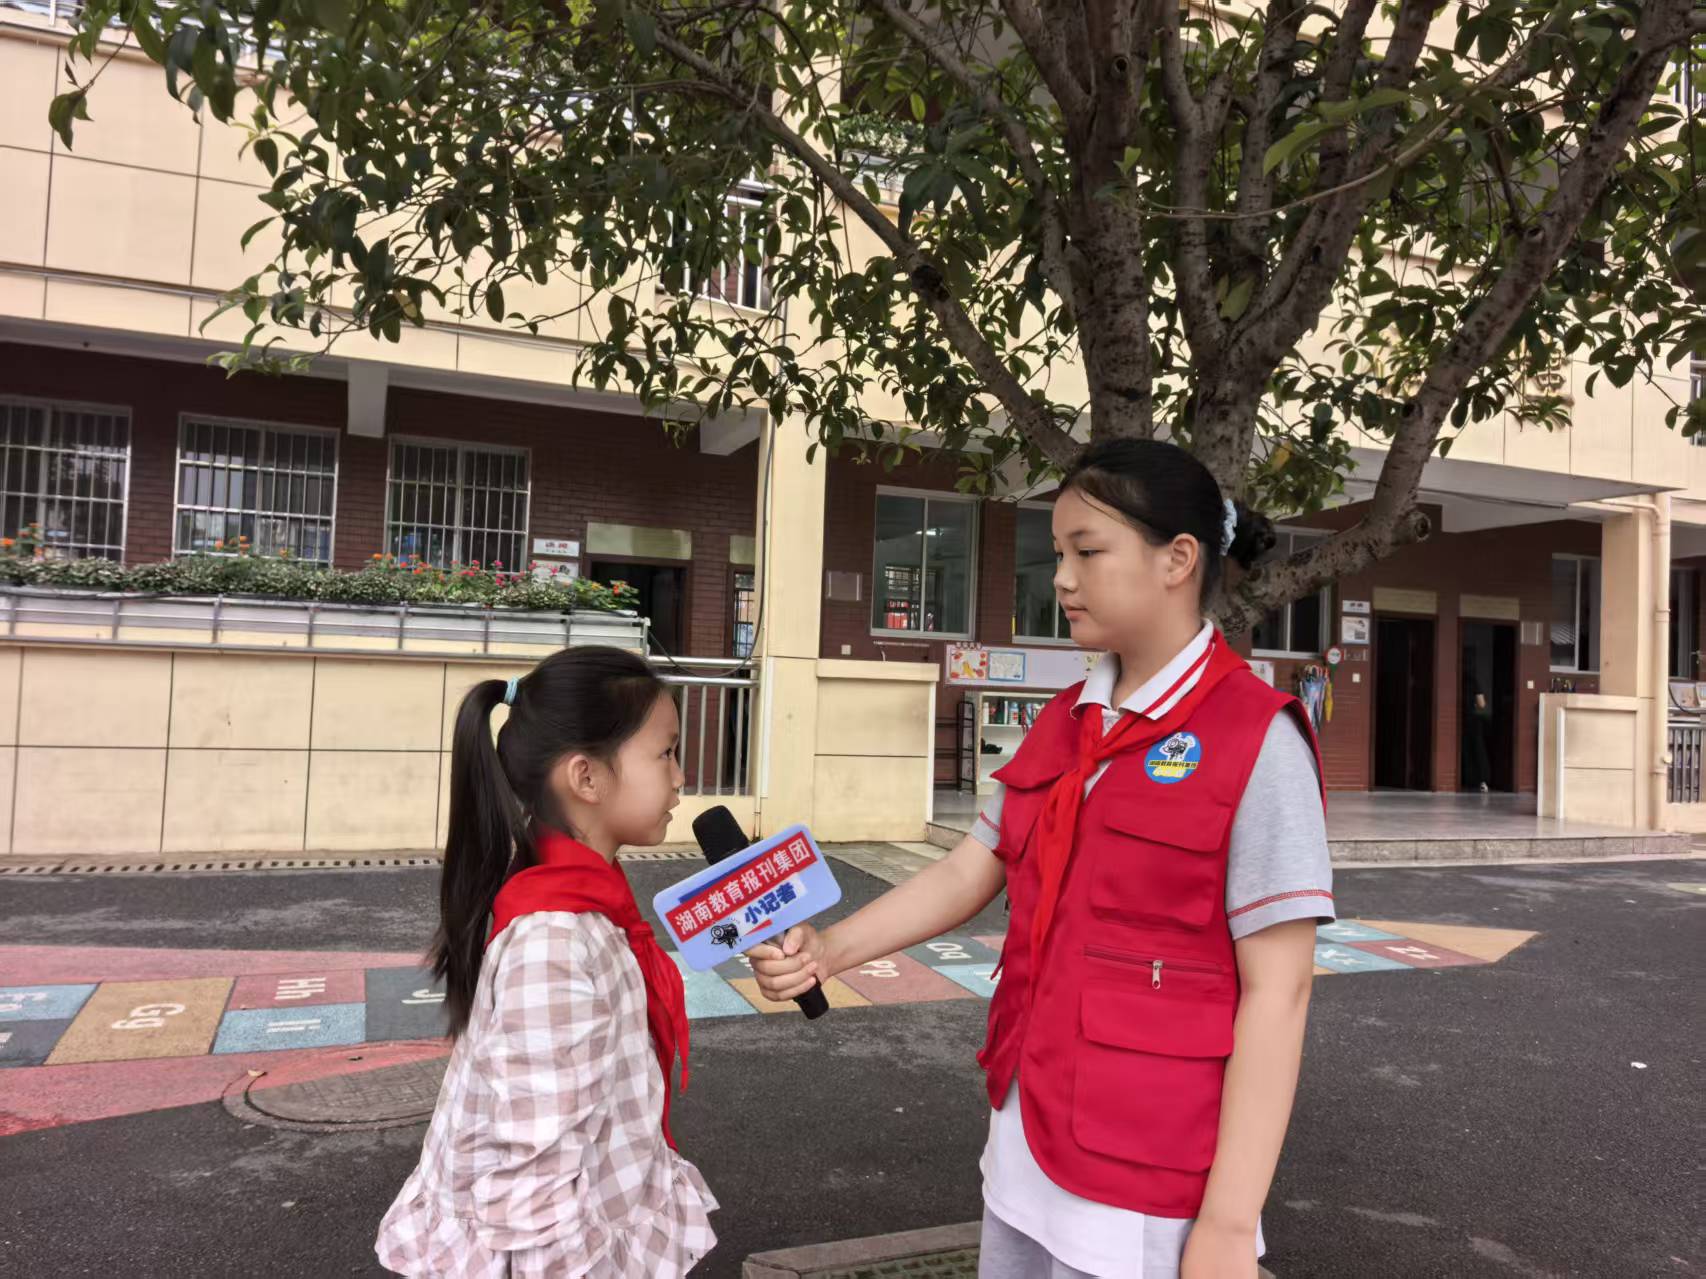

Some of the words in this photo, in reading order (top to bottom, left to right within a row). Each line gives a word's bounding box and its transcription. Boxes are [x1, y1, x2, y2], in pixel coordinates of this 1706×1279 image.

[675, 838, 811, 935] 湖南教育报刊集团
[744, 881, 797, 925] 小记者
[274, 977, 326, 1000] Hh
[111, 1003, 186, 1030] Gg
